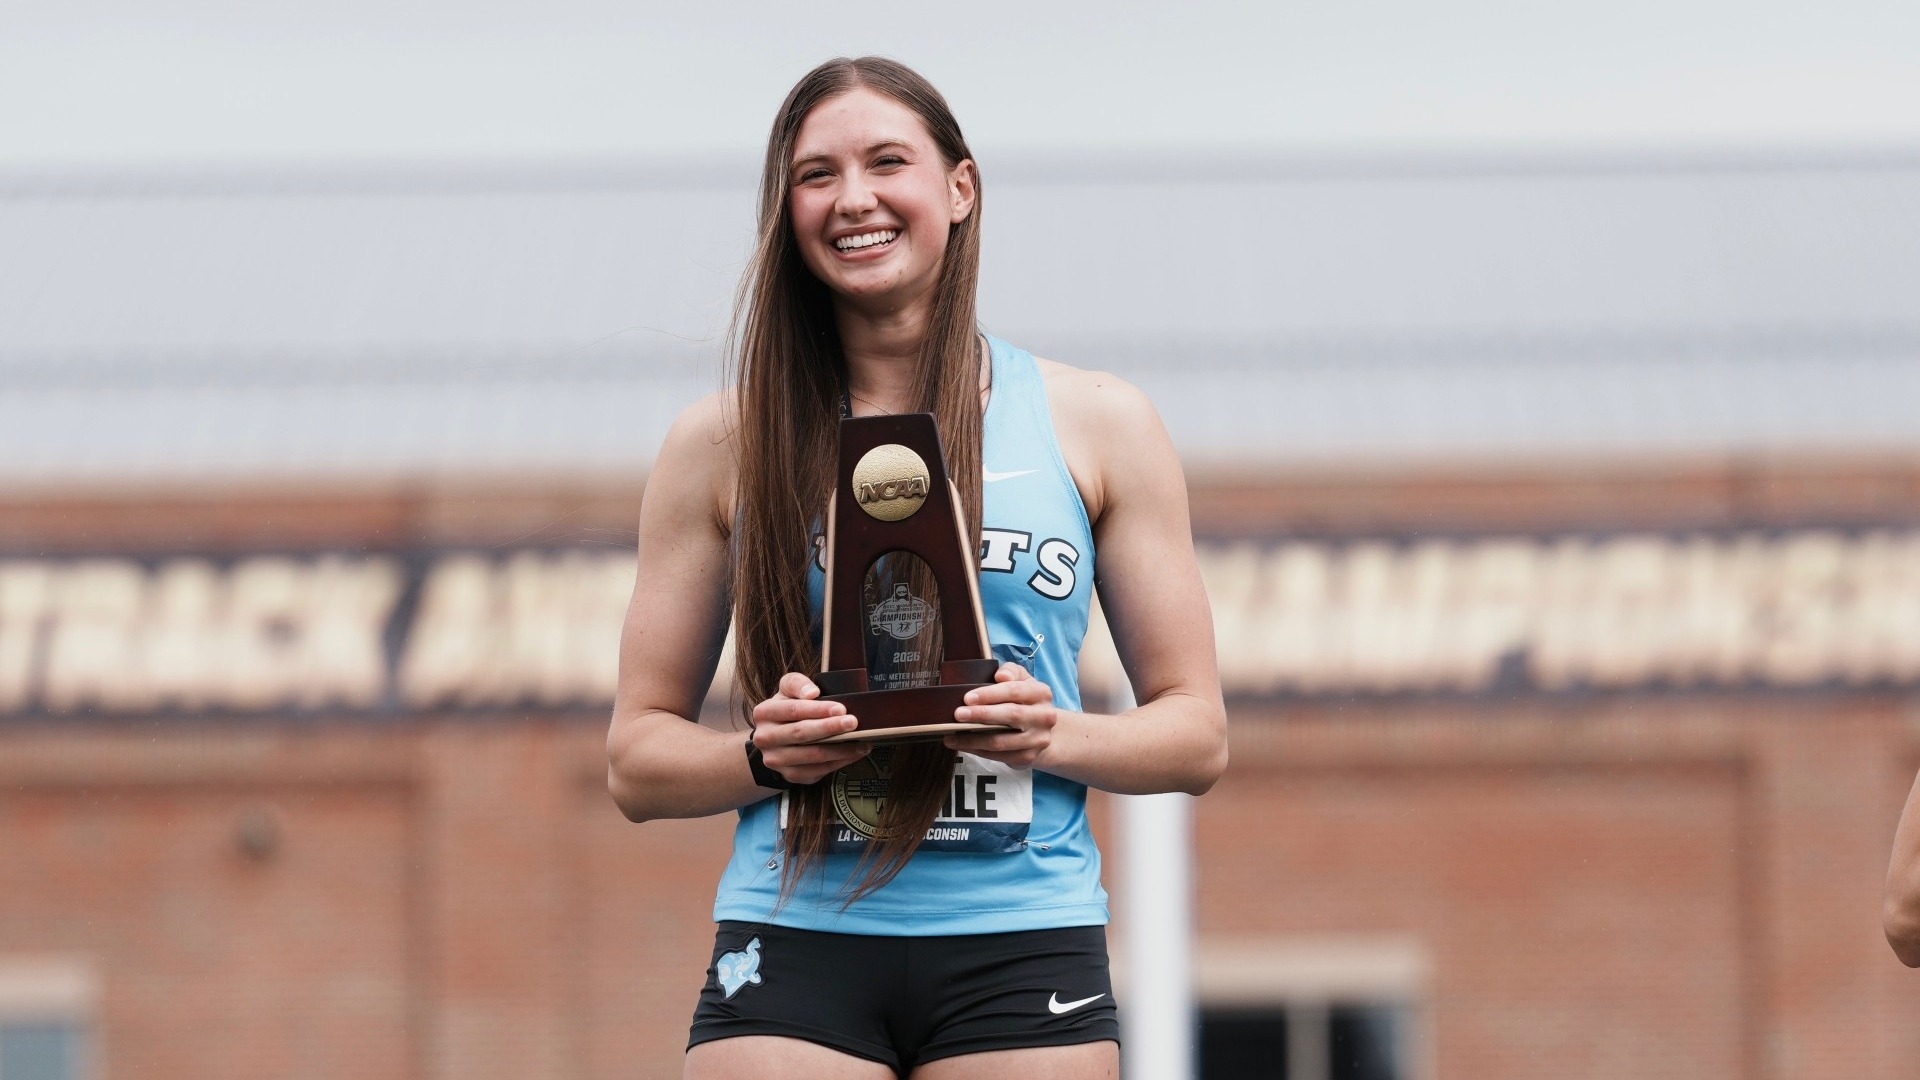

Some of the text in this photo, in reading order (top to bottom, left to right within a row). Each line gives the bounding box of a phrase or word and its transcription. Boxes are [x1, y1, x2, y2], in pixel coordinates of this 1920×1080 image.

[861, 476, 927, 503] NCAA
[872, 610, 935, 622] CHAMPIONSHIS
[892, 651, 921, 663] 2026
[889, 672, 910, 680] METER
[839, 799, 862, 828] DIVISION
[837, 829, 851, 842] LA
[911, 827, 970, 841] CONSIN
